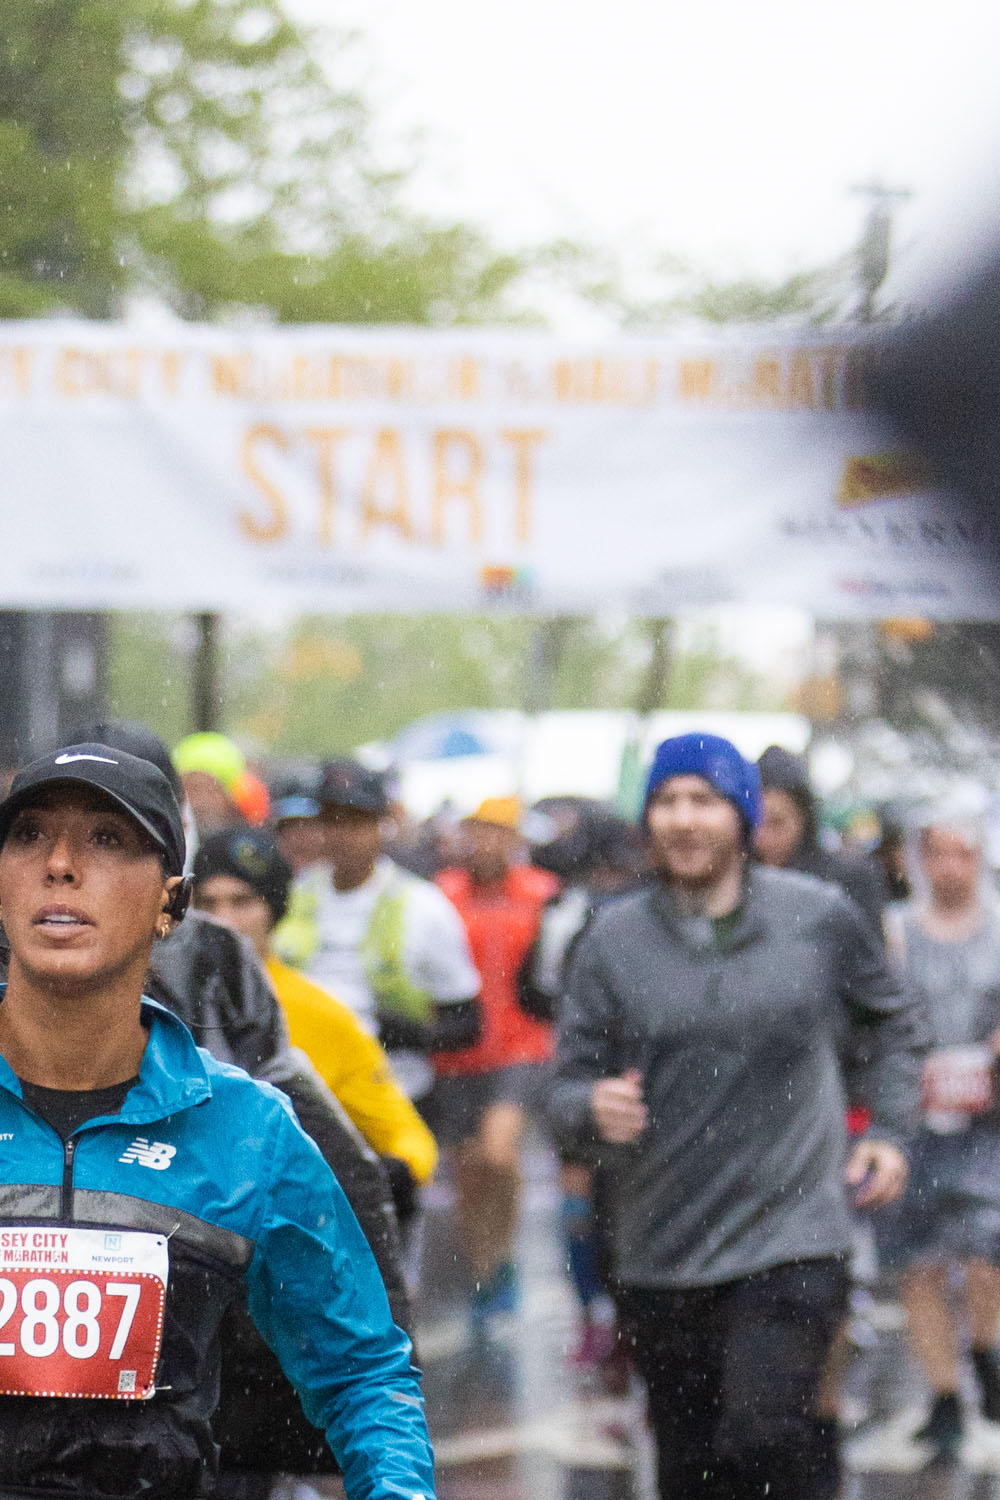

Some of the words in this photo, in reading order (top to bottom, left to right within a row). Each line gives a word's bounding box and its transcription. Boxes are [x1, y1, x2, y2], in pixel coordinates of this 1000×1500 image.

[54, 345, 187, 398] CITY
[235, 423, 551, 547] START
[33, 1233, 69, 1249] CITY
[3, 1250, 69, 1264] MARATHON
[91, 1255, 135, 1265] NEWPORT
